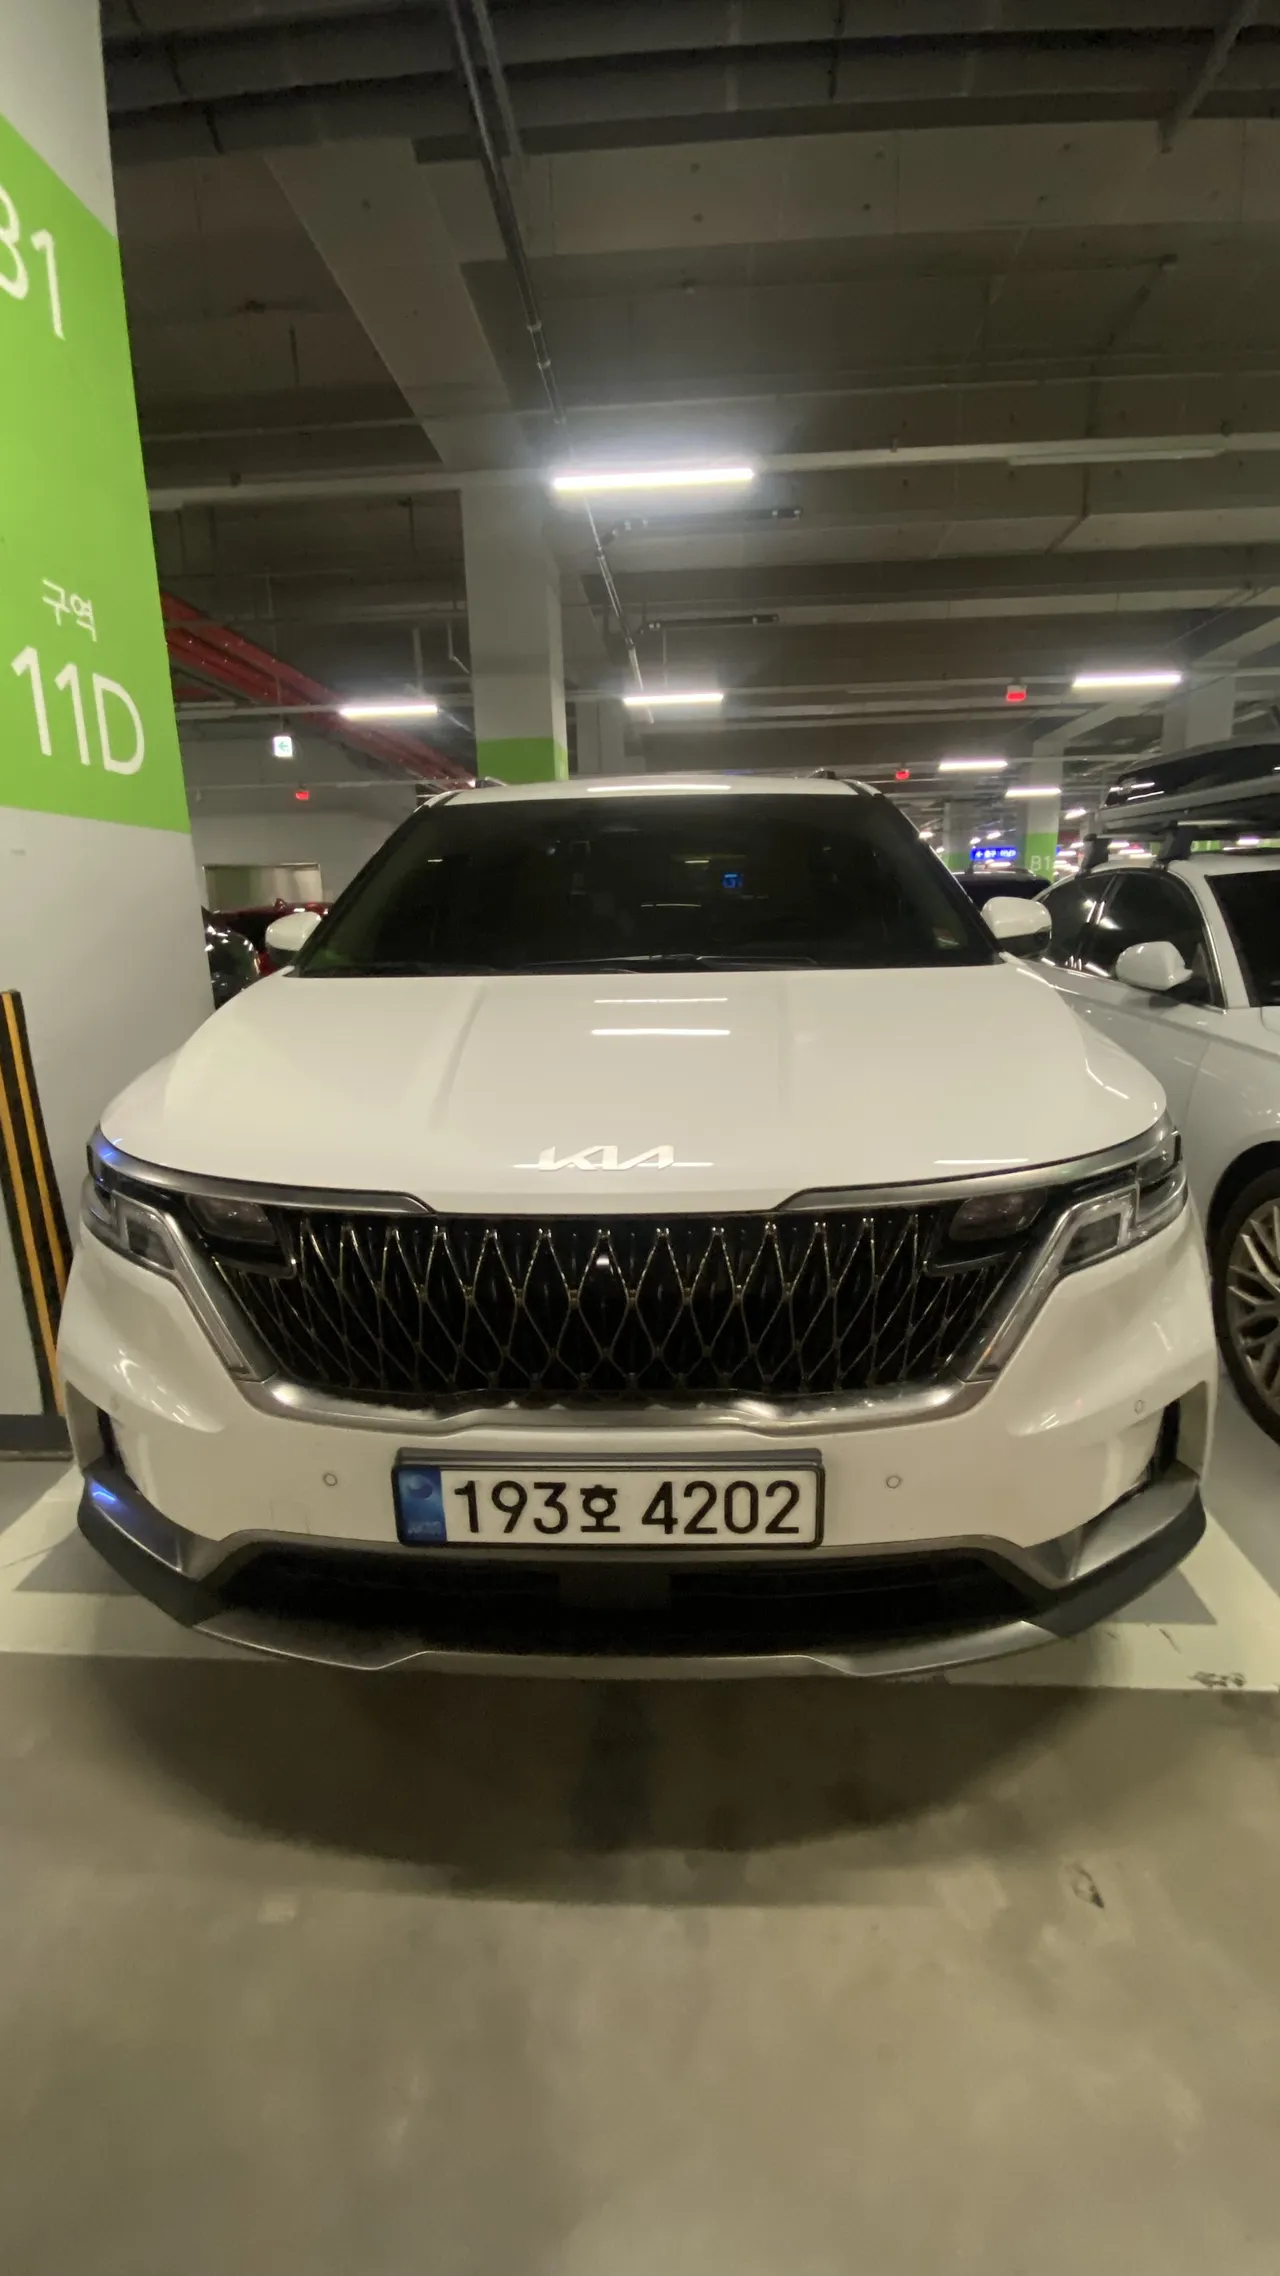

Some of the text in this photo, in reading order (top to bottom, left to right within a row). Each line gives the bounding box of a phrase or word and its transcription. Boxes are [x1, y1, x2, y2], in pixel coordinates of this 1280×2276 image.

[42, 577, 98, 642] 구역
[11, 645, 145, 775] 11D
[1031, 855, 1051, 871] B1
[538, 1145, 675, 1171] KIA
[453, 1480, 801, 1535] 193호 4202
